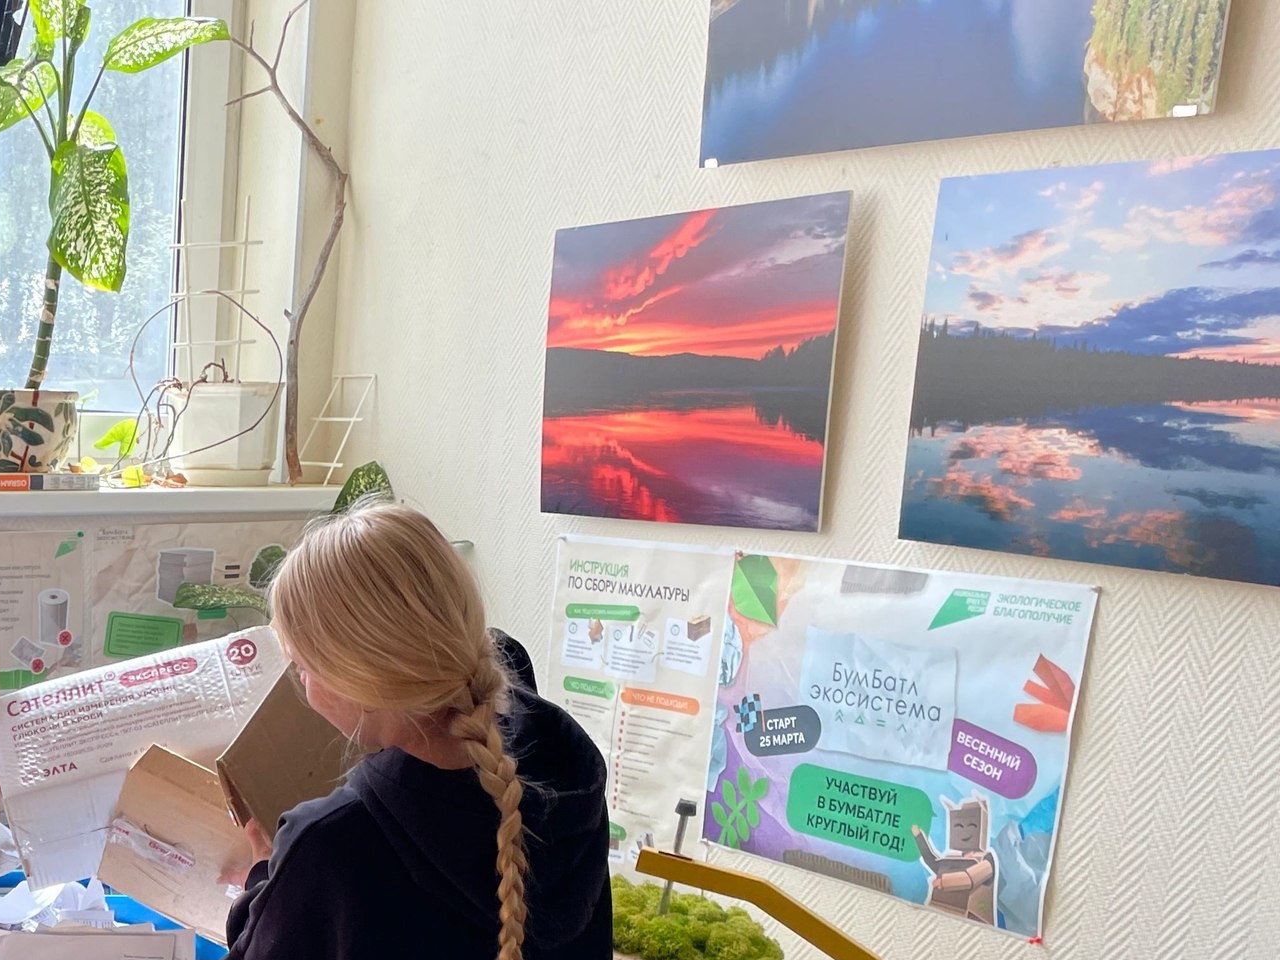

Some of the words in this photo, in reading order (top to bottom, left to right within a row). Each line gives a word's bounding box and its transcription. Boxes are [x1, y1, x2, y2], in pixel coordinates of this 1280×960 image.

[569, 559, 630, 578] ИНСТРУКЦИЯ
[568, 575, 583, 589] ПО
[585, 577, 617, 594] СБОРУ
[618, 582, 690, 602] МАКУЛАТУРЫ
[996, 593, 1082, 612] ЭКОЛОГИЧЕСКОЕ
[993, 606, 1074, 625] БЛАГОПОЛУЧИЕ
[127, 661, 191, 683] ЭКСПРЕСС
[228, 643, 255, 662] 20
[11, 715, 54, 732] СИСТЕМА
[63, 719, 70, 727] В
[70, 711, 104, 725] КРОВИ
[766, 716, 797, 731] СТАРТ
[759, 735, 771, 748] 25
[772, 732, 805, 747] МАРТА
[956, 730, 1021, 772] ВЕСЕННИЙ
[42, 762, 78, 777] ЭЛТА
[963, 753, 1003, 782] СЕЗОН
[825, 776, 898, 806] УЧАСТВУЙ
[817, 796, 825, 808] В
[828, 798, 901, 828] БУМБАТЛЕ
[806, 813, 870, 843] КРУГЛЫЙ
[872, 831, 906, 853] ГОД!
